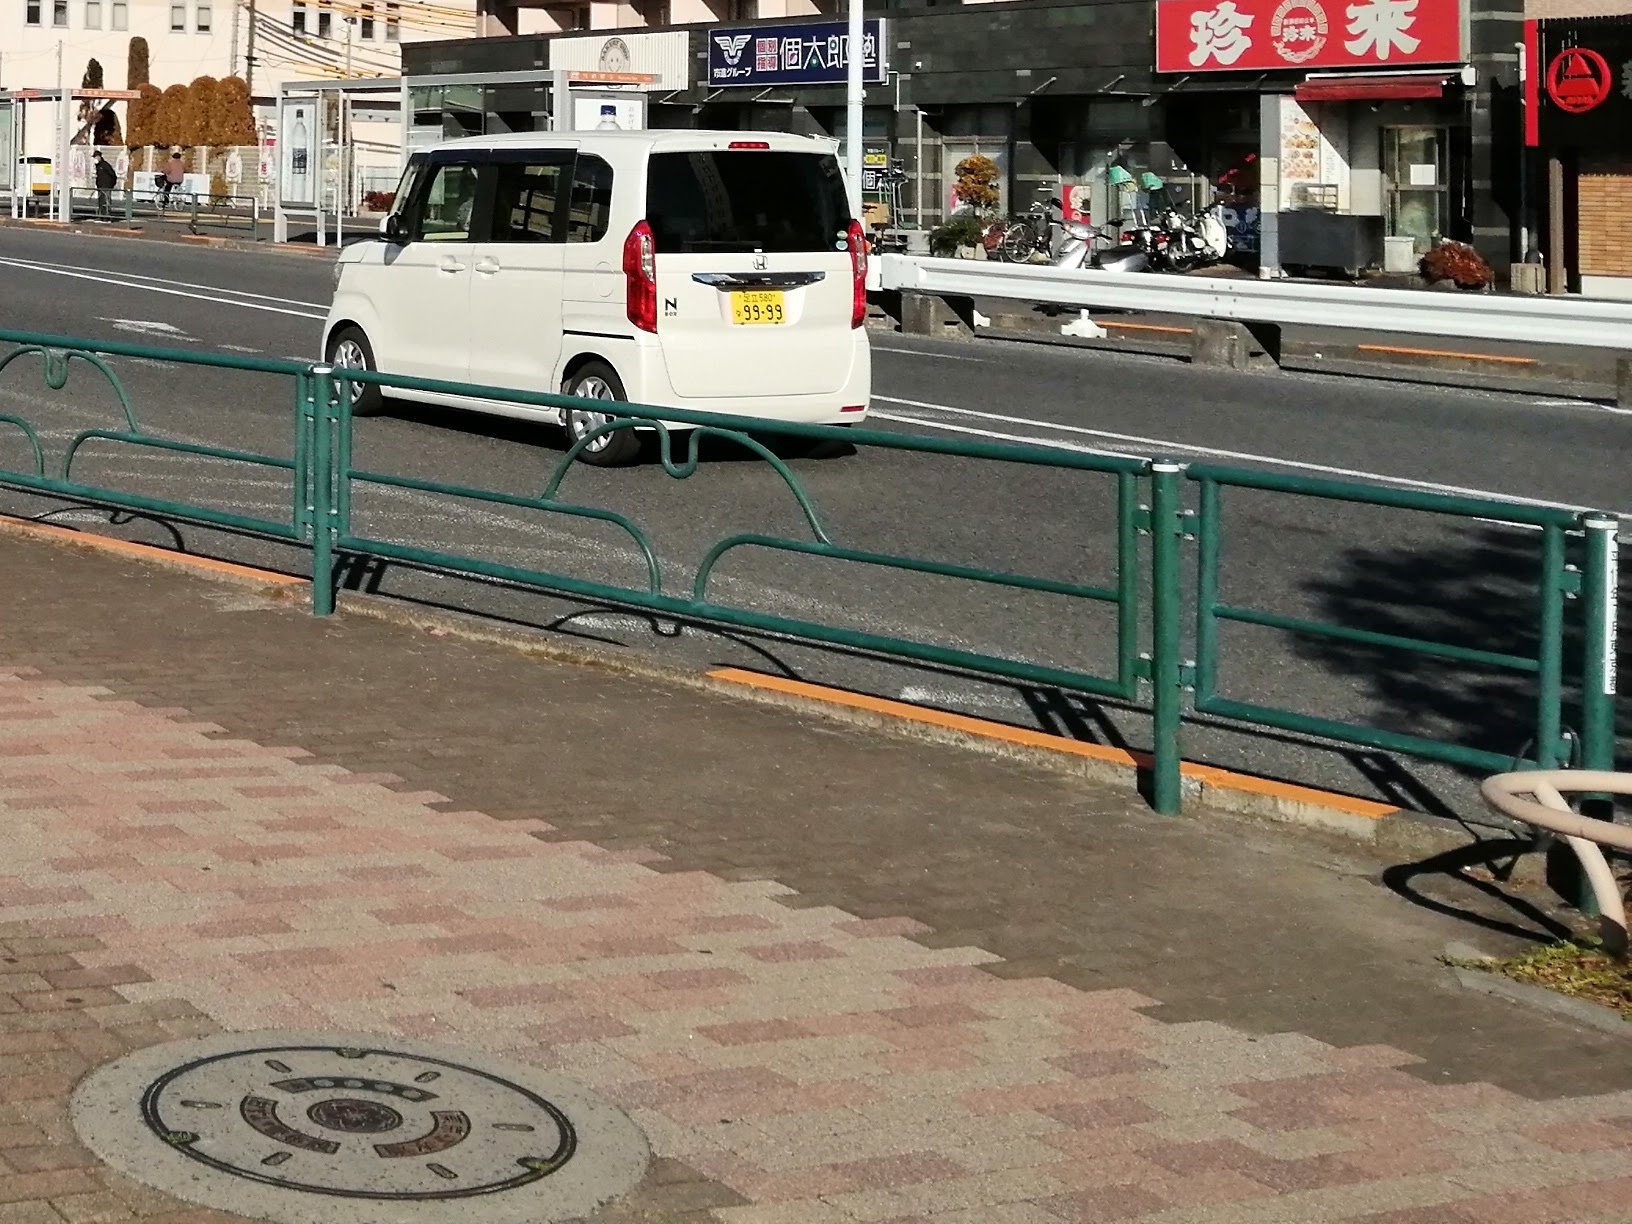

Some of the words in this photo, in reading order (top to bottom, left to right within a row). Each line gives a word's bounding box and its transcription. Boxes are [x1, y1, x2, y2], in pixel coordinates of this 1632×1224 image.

[757, 39, 777, 54] 個別
[757, 55, 777, 71] 指導
[664, 297, 677, 311] N
